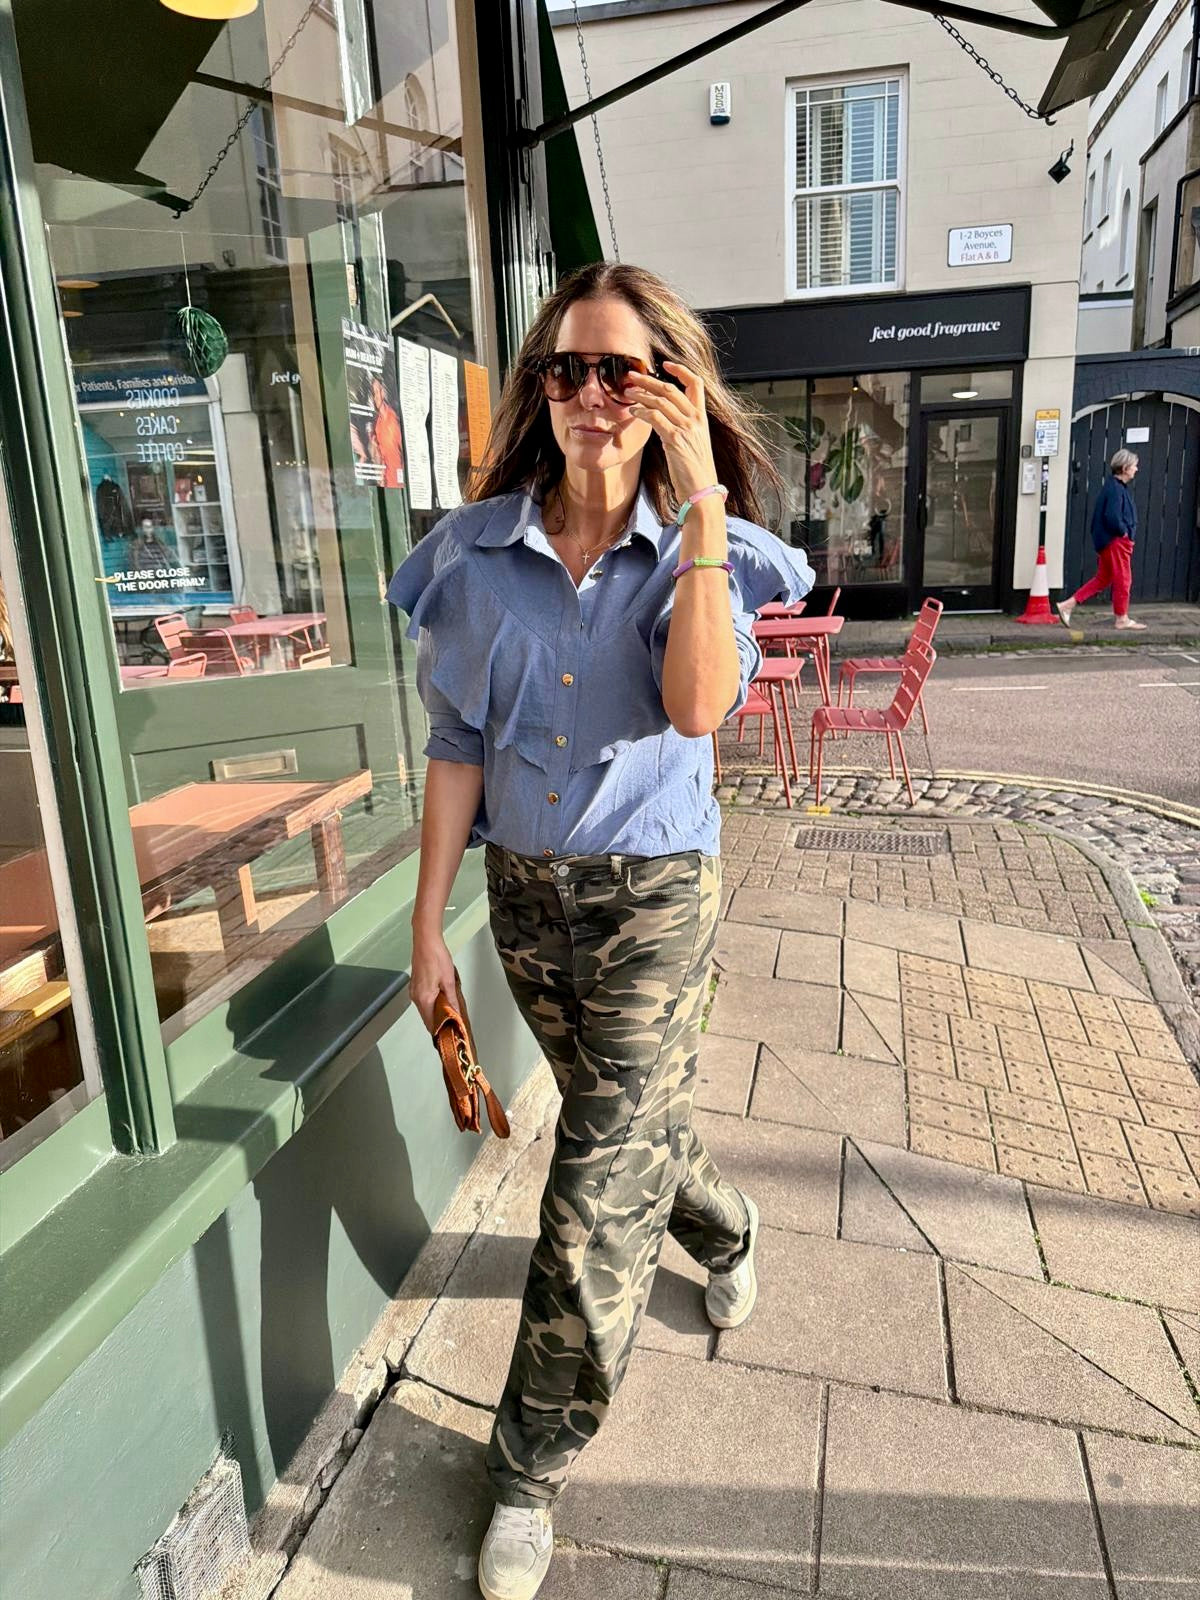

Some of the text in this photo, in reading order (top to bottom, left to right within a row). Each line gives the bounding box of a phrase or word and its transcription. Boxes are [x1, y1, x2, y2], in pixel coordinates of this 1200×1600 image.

[974, 230, 1003, 240] Boyces
[960, 252, 976, 262] Flat
[977, 252, 984, 260] A
[869, 321, 1000, 342] feel good fragrance
[81, 381, 117, 392] Patients,
[117, 378, 151, 389] Families
[114, 567, 190, 580] PLEASE CLOSE
[115, 577, 206, 592] THE DOOR FIRMLY
